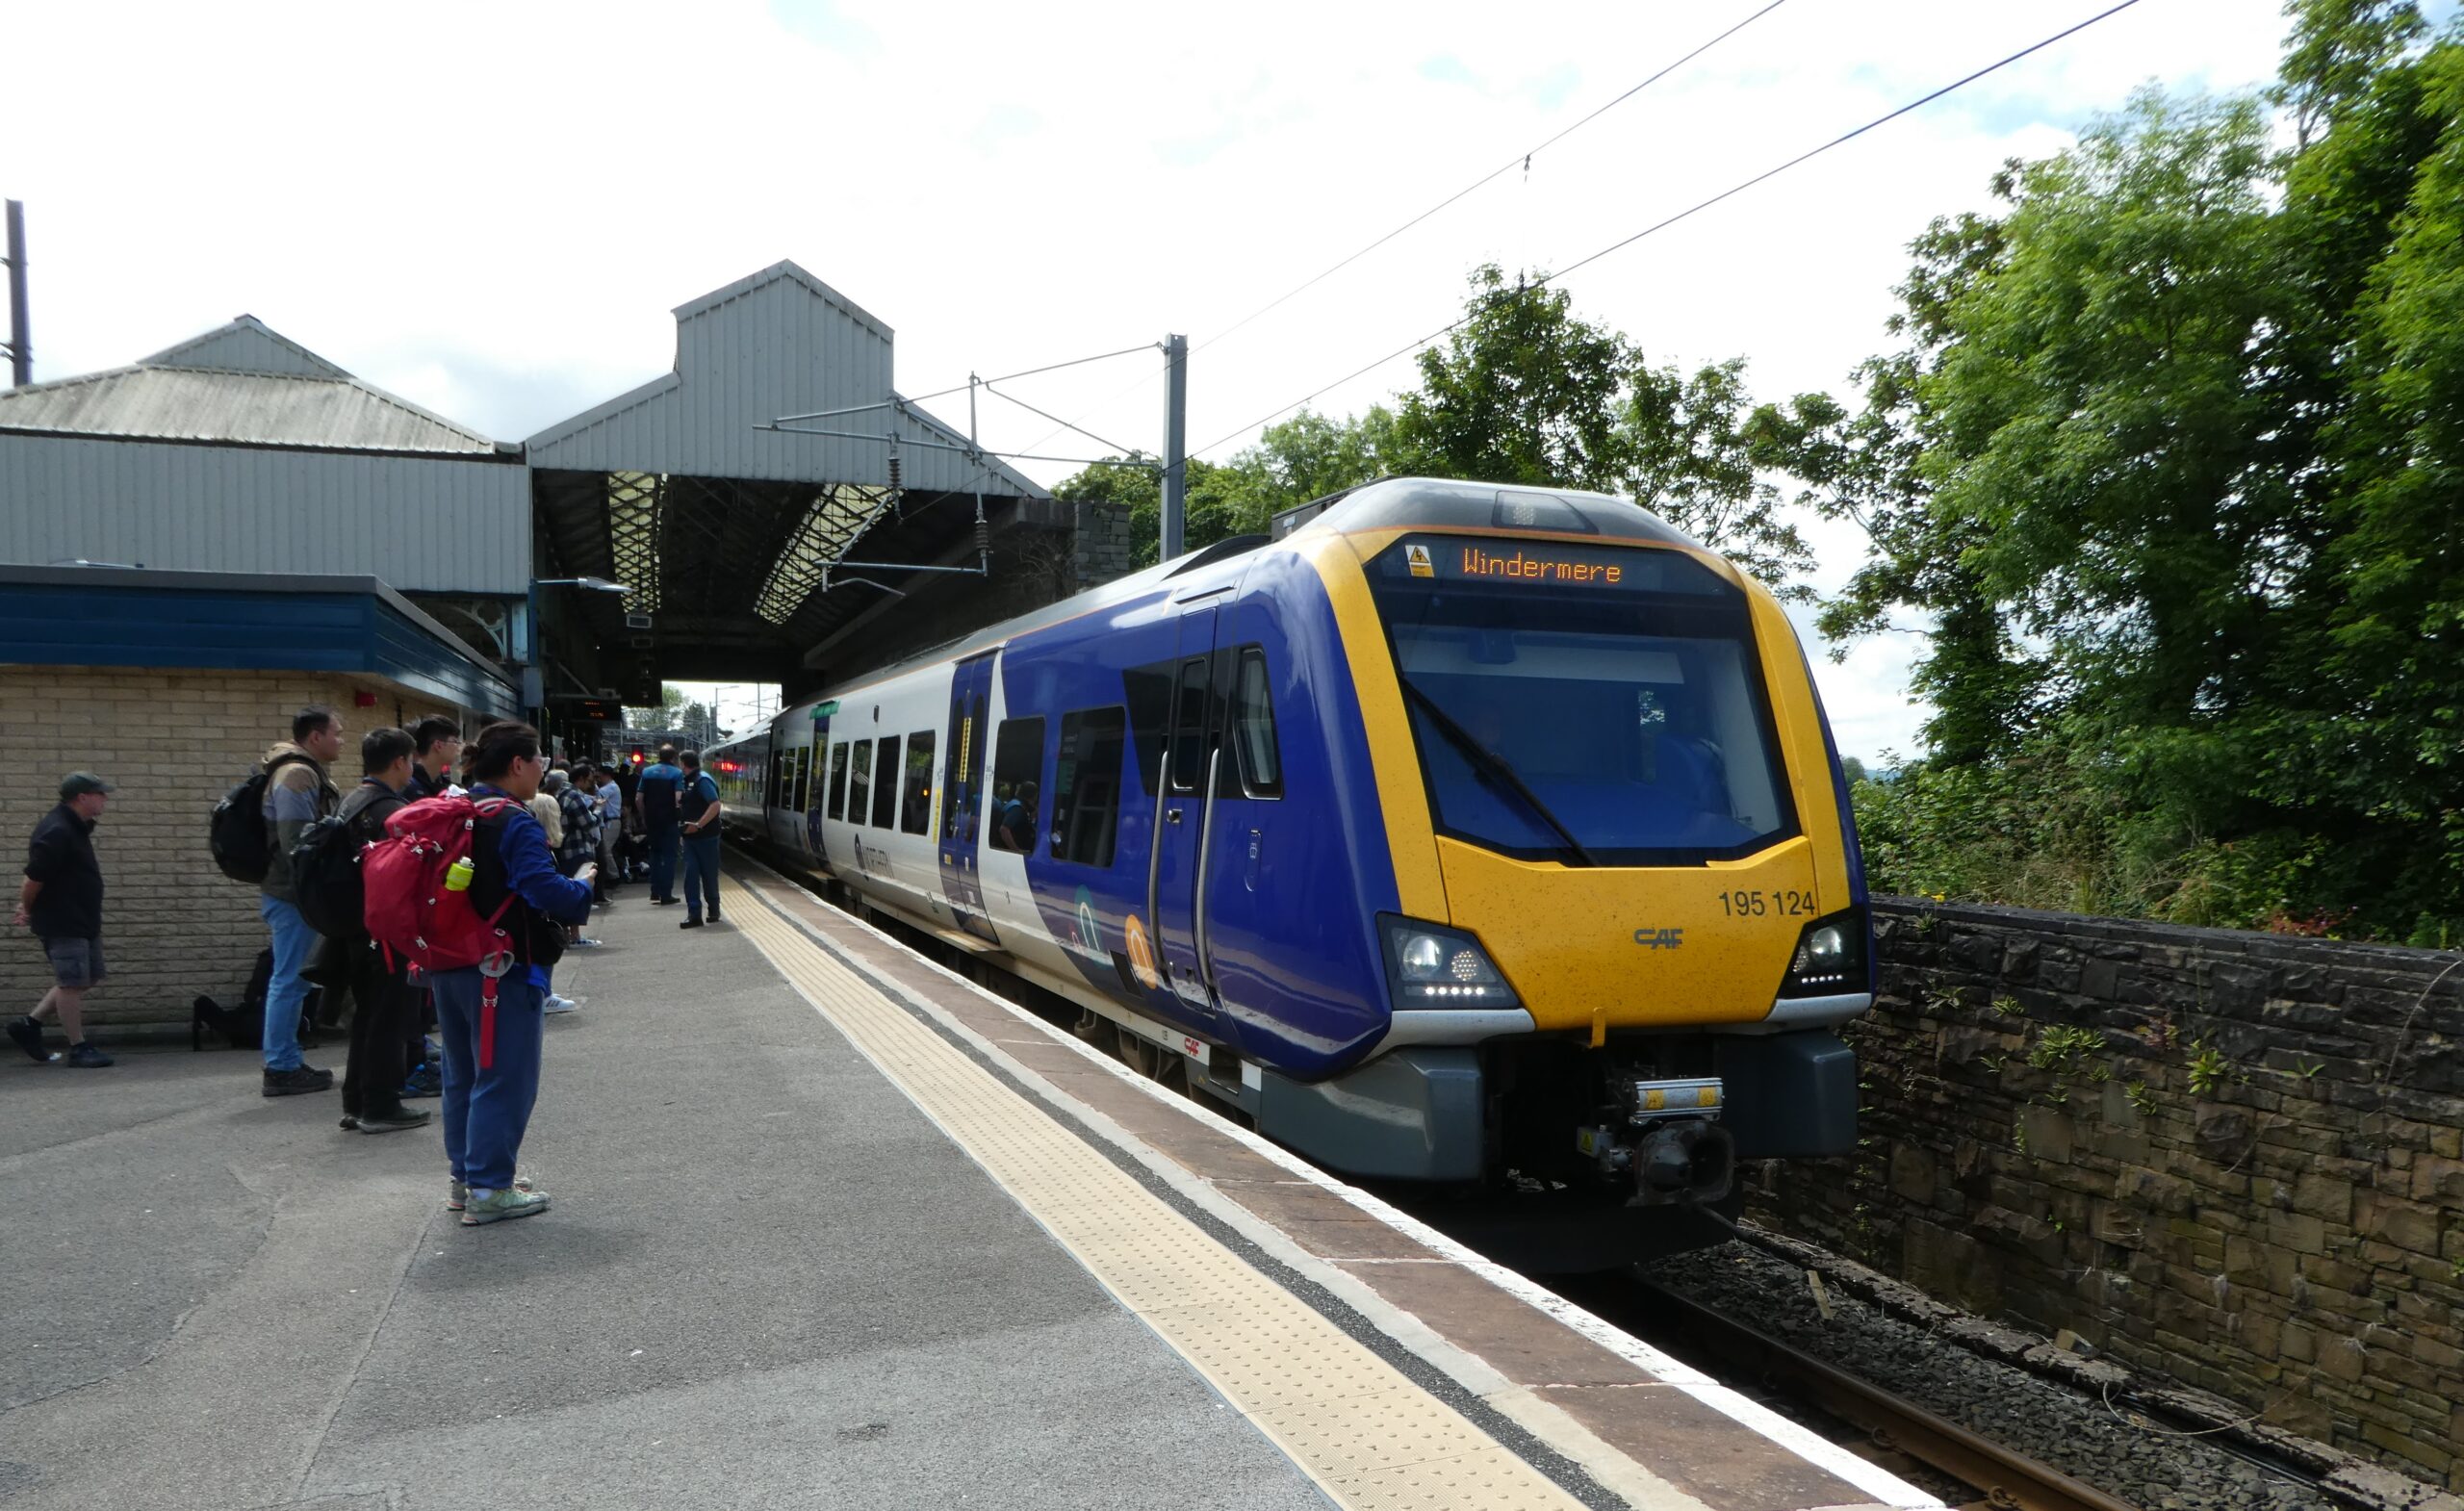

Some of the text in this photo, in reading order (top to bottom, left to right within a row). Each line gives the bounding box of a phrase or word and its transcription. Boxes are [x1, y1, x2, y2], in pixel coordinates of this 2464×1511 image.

[1464, 548, 1622, 583] Windermere
[1719, 890, 1815, 916] 195 124
[1633, 928, 1684, 950] CAF
